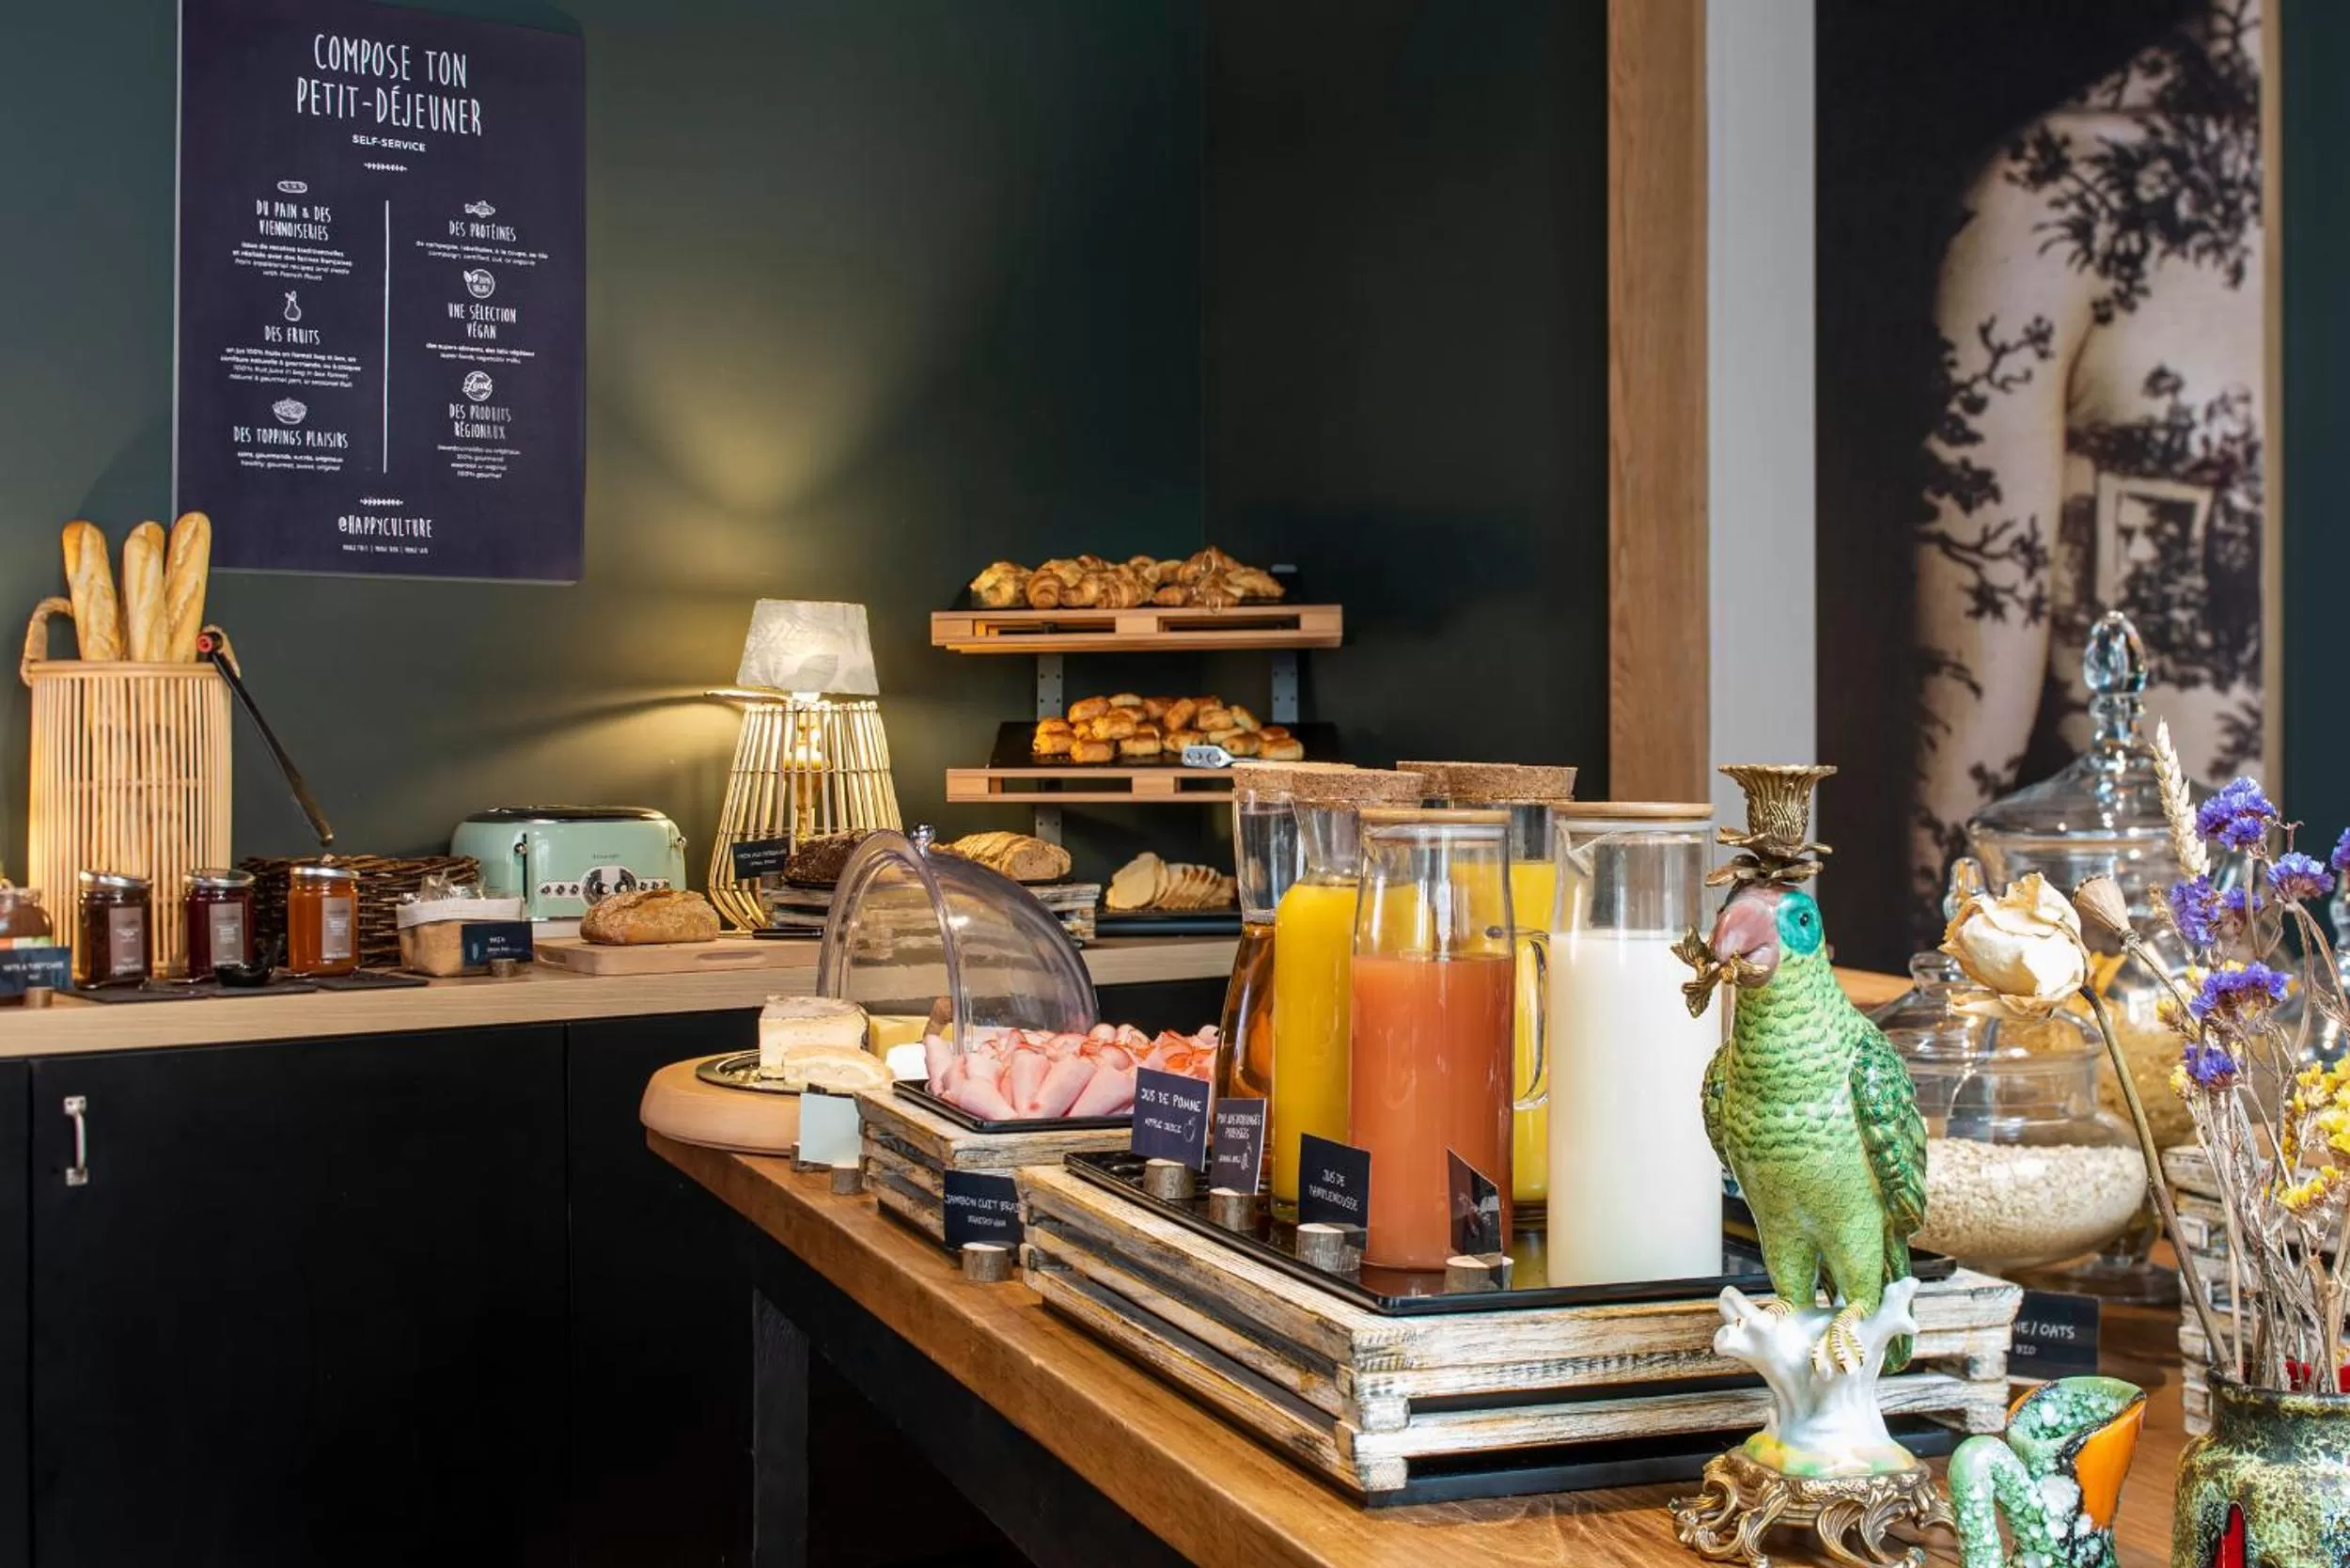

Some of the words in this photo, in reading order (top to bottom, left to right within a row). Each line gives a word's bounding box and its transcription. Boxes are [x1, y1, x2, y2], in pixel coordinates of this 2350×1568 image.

[314, 34, 411, 81] COMPOSE
[425, 51, 467, 88] TON
[296, 76, 482, 136] PETIT-DÉJEUNER
[352, 133, 427, 152] SELF-SERVICE
[256, 199, 269, 216] DU
[274, 201, 297, 219] PAIN
[302, 207, 309, 218] &
[314, 206, 332, 224] DES
[259, 219, 329, 241] VIENNOISERIES
[448, 220, 466, 237] DES
[470, 223, 517, 243] PROTÉINES
[447, 302, 464, 319] UNE
[469, 303, 516, 323] SÉLECTION
[264, 325, 282, 342] DES
[287, 326, 321, 345] FRUITS
[466, 321, 496, 338] VÉGAN
[449, 402, 466, 419] DES
[470, 404, 511, 423] PRODUITS
[233, 425, 251, 443] DES
[257, 428, 301, 446] TOPPINGS
[306, 431, 349, 448] PLAISIRS
[338, 514, 432, 538] @HAPPYCULTURE
[1140, 1088, 1156, 1103] JUS
[1158, 1091, 1170, 1105] DE
[1172, 1094, 1203, 1112] POMME
[945, 1195, 977, 1208] JAMBON
[978, 1198, 998, 1210] CUIT
[2039, 1323, 2076, 1341] OATS
